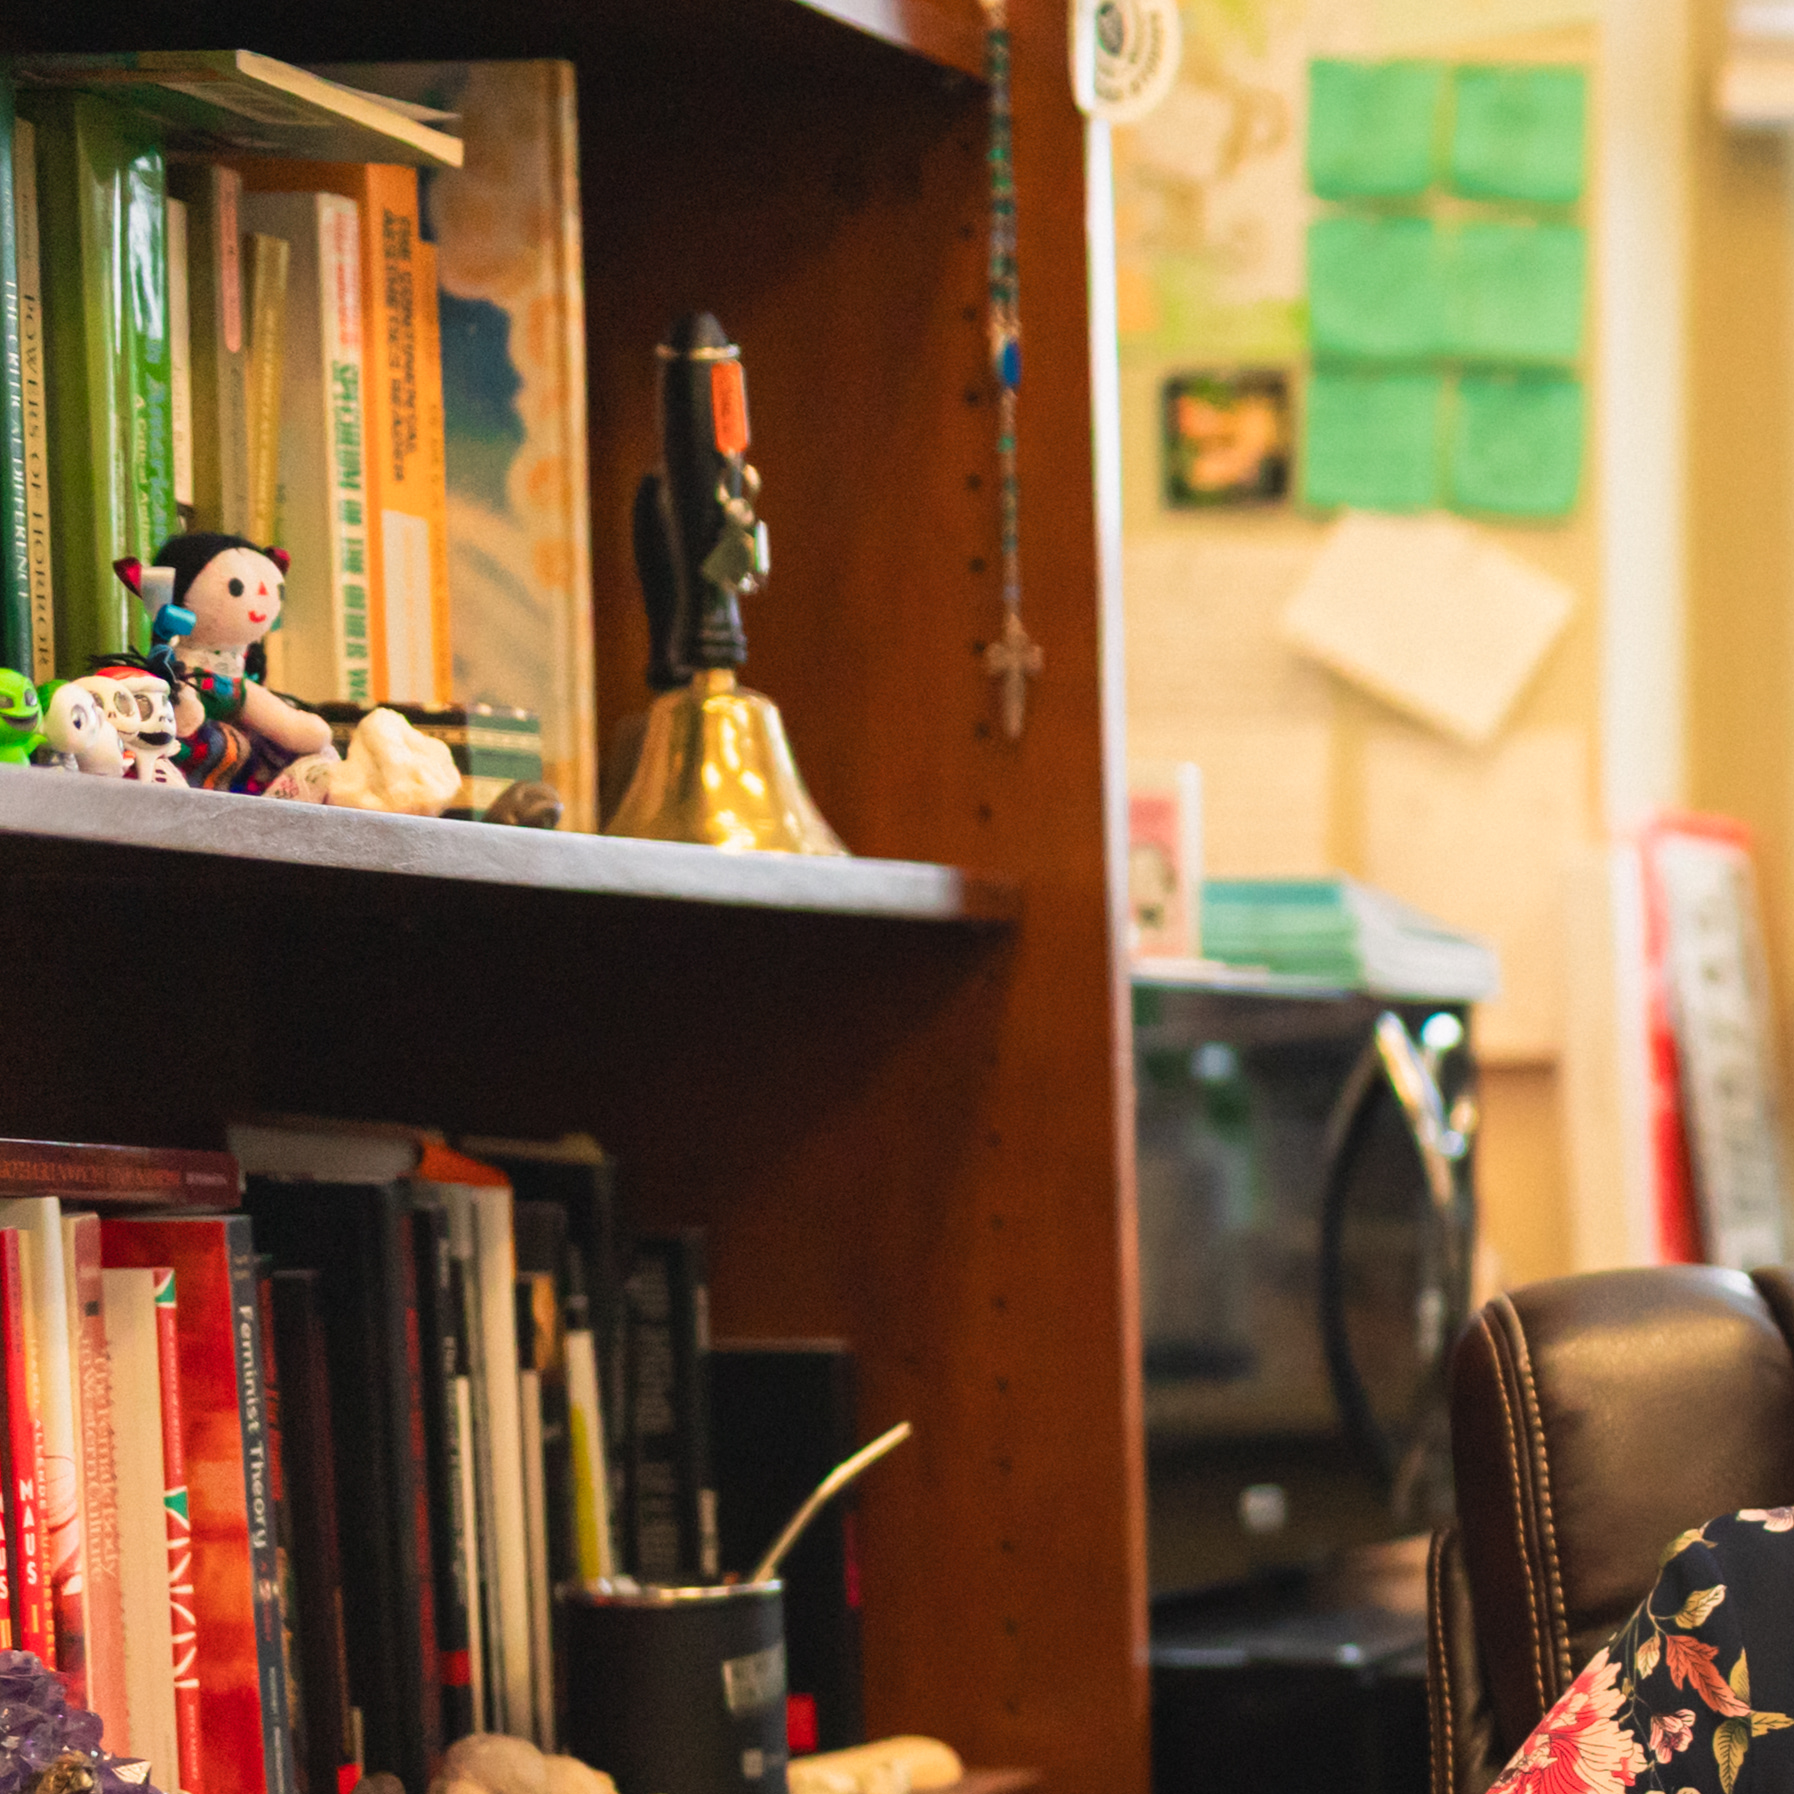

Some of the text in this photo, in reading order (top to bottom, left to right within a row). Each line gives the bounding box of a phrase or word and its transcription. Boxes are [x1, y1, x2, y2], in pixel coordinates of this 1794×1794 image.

[239, 1304, 260, 1432] Feminist
[20, 1478, 38, 1586] MAUS
[249, 1440, 269, 1550] Theory
